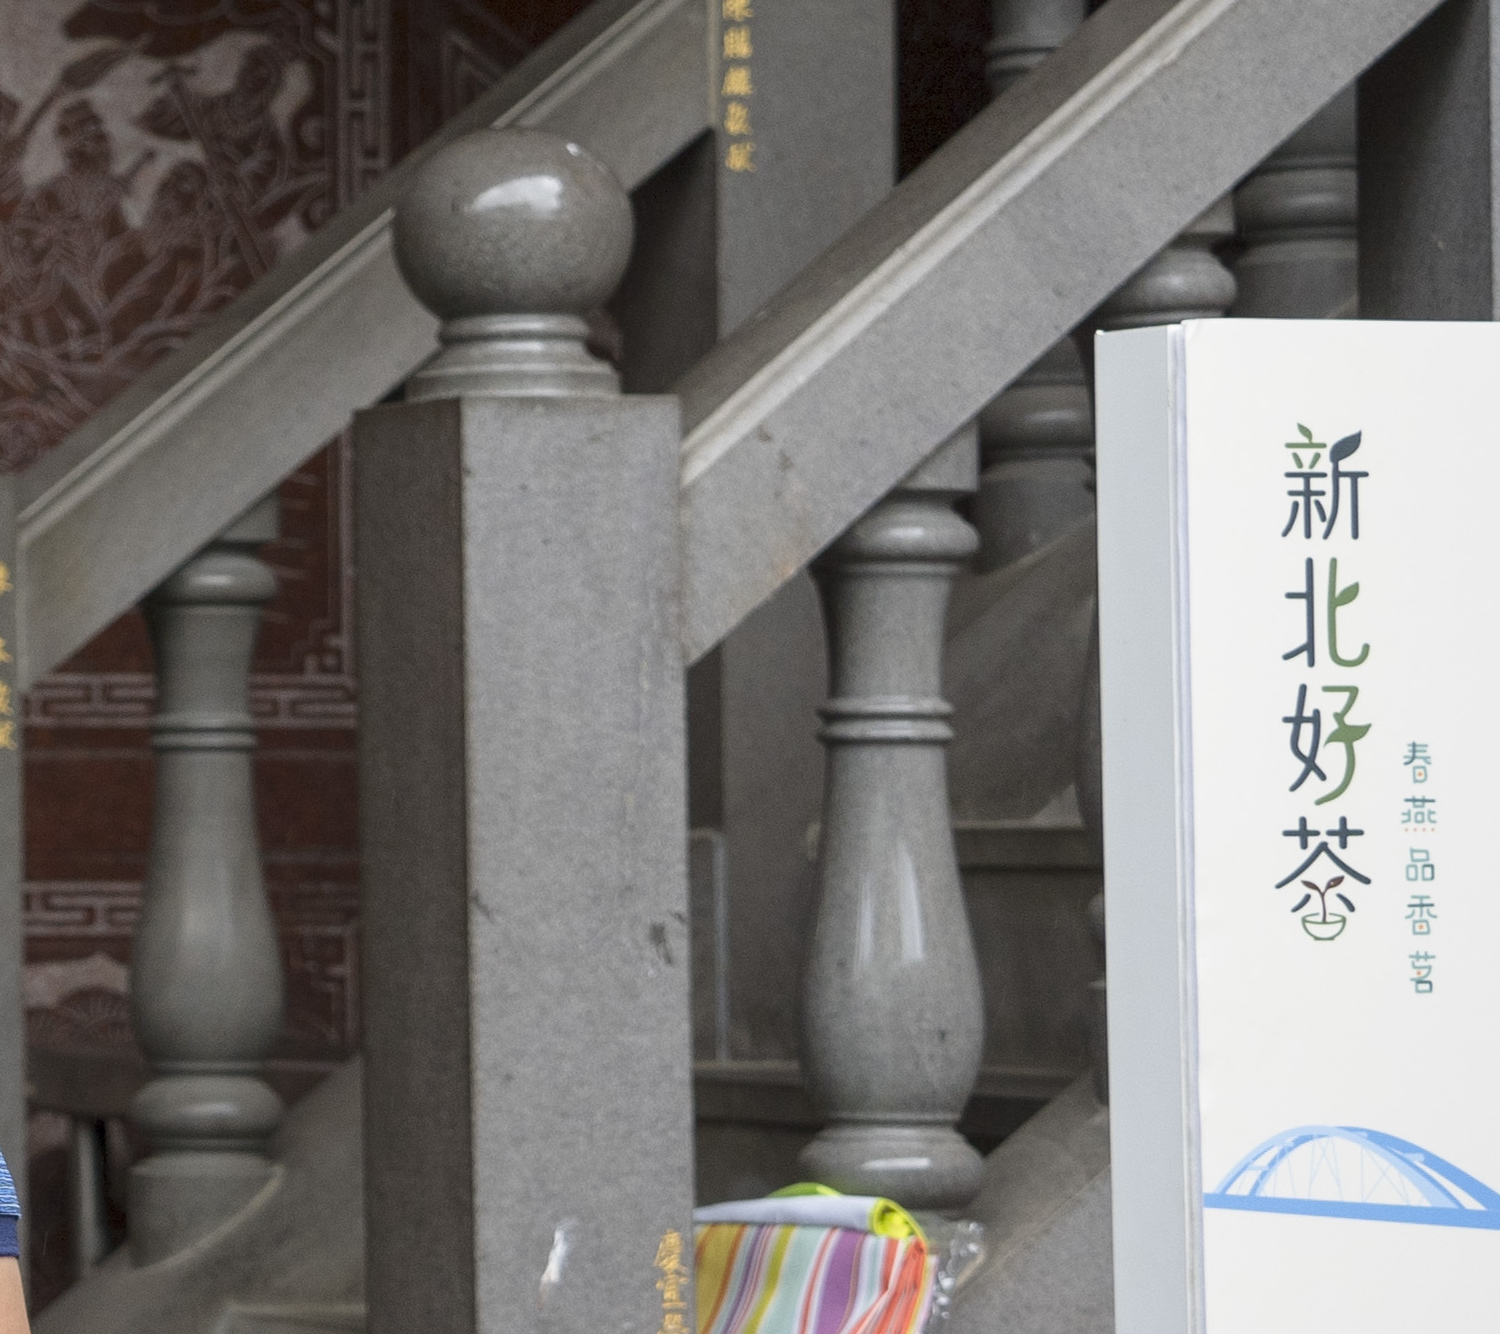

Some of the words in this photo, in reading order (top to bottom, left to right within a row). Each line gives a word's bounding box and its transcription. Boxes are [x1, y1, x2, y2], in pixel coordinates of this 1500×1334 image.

[1274, 420, 1375, 943] 新北好茶
[1398, 739, 1440, 997] 春燕品香茗
